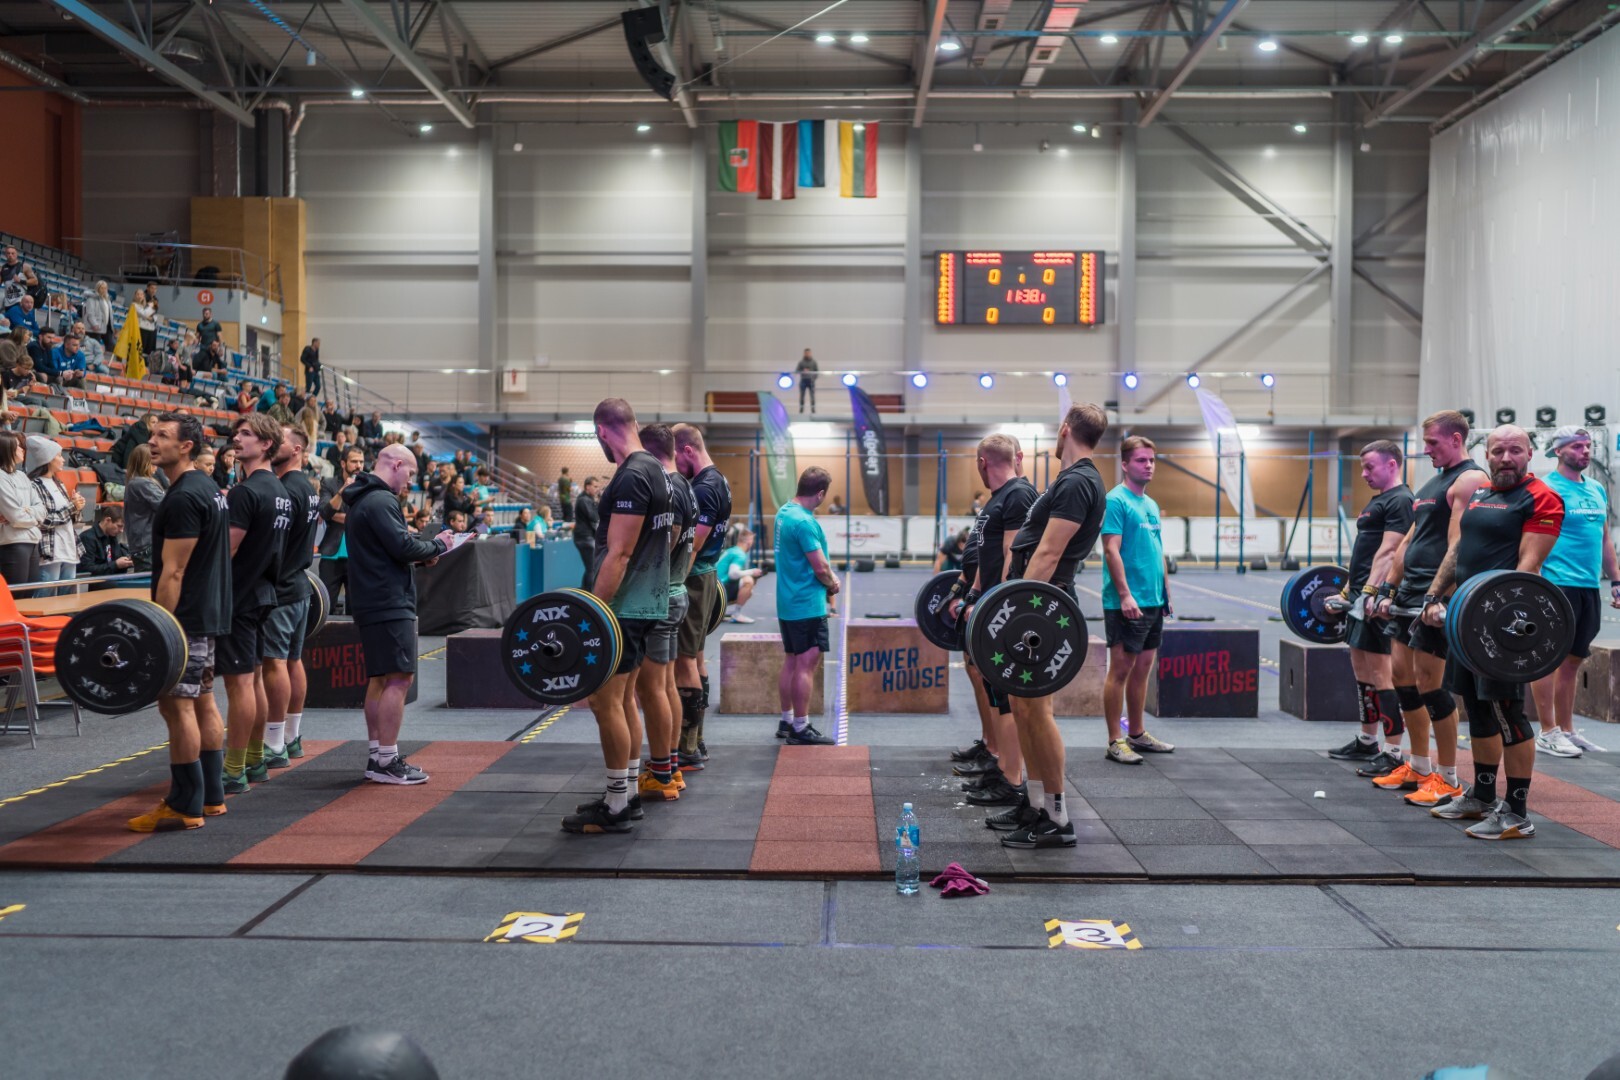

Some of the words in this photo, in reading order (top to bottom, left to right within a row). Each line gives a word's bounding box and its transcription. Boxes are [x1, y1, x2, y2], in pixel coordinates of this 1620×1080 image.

[1043, 268, 1056, 285] 0
[986, 307, 999, 324] 0
[1043, 307, 1056, 324] 0
[616, 500, 633, 508] 2024
[1300, 574, 1323, 600] ATX
[532, 605, 570, 623] ATX
[987, 600, 1017, 640] ATX
[849, 647, 919, 674] POWER
[1044, 638, 1073, 680] ATX
[1159, 650, 1231, 680] POWER
[331, 663, 368, 689] HOU
[542, 674, 581, 691] ATX
[882, 665, 946, 693] HOUSE
[1192, 669, 1258, 698] HOUSE
[513, 921, 554, 938] 2
[1073, 927, 1112, 943] 3
